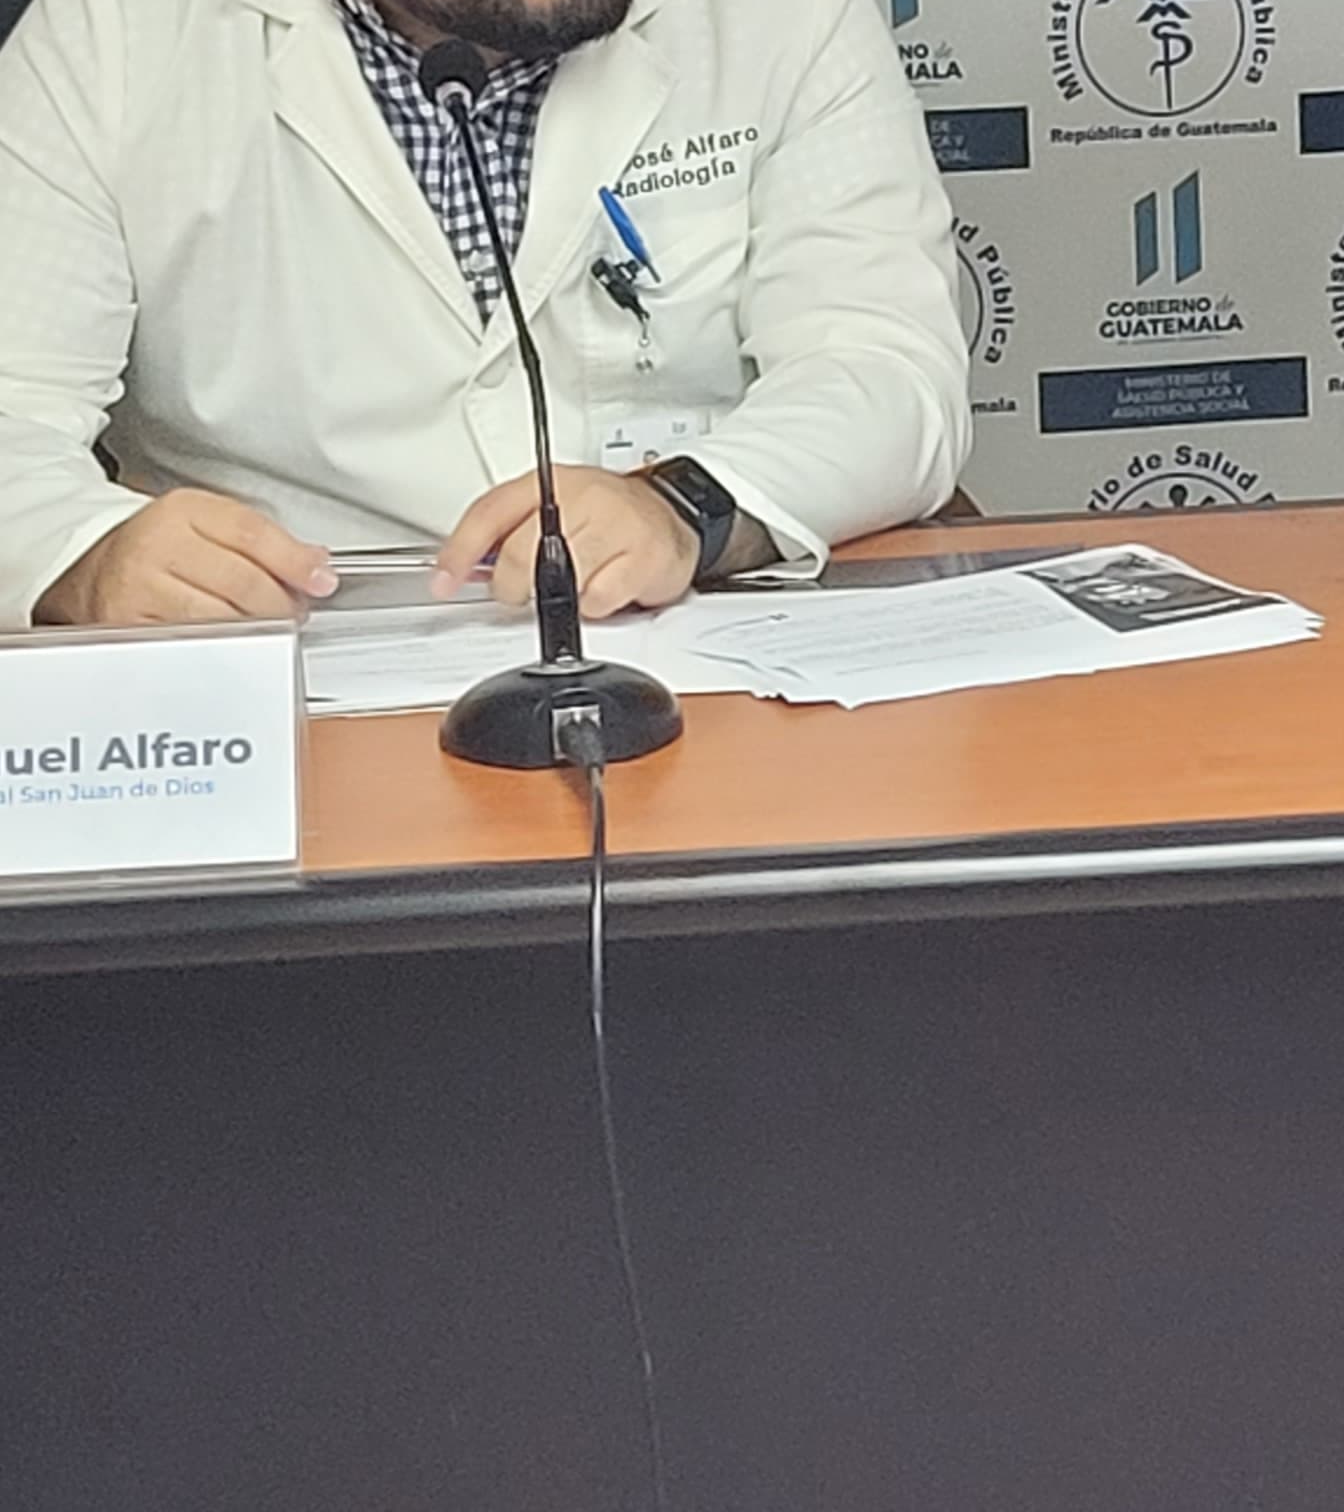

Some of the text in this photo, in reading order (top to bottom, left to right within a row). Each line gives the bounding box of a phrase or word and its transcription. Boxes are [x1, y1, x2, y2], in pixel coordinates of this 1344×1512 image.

[685, 127, 758, 159] Alfaro
[97, 732, 253, 771] Alfaro
[20, 786, 61, 803] San
[67, 783, 123, 801] Juan
[129, 779, 157, 797] de
[165, 778, 215, 796] Dios
